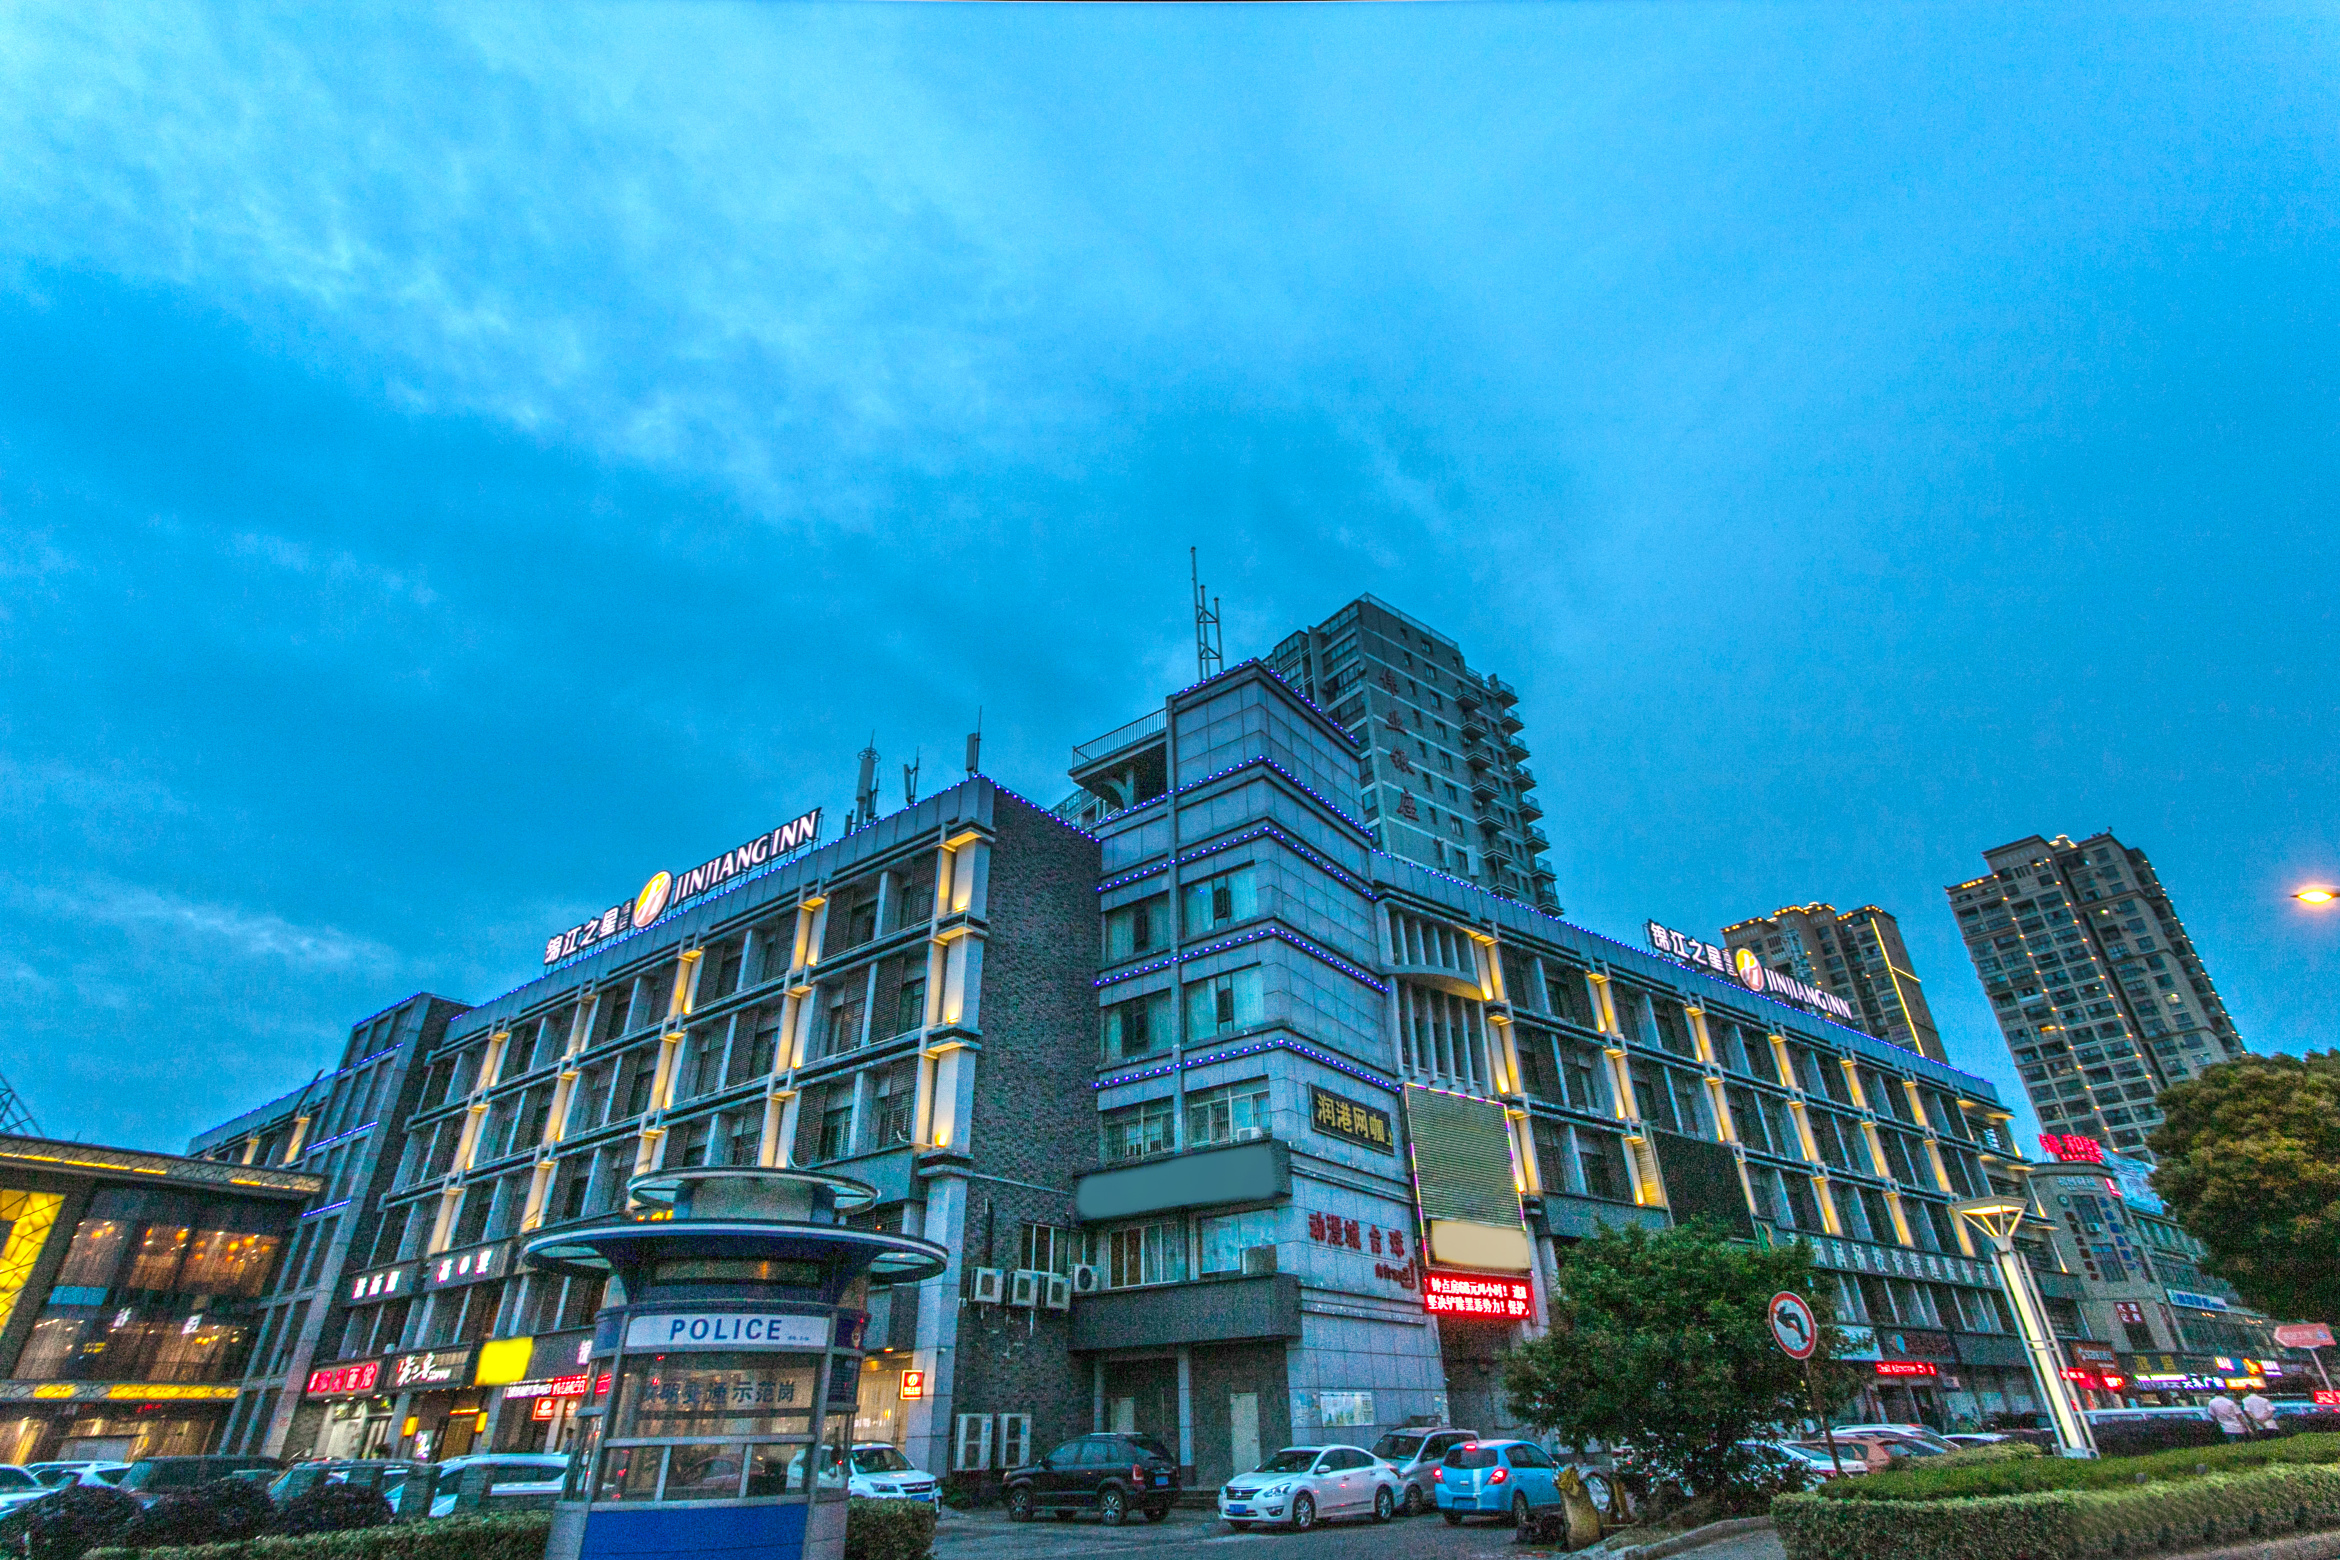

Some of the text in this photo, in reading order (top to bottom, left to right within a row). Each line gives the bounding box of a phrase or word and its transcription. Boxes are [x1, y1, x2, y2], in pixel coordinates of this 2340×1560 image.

[674, 810, 820, 903] JINJIANG INN
[544, 907, 619, 963] 锦江之星
[1650, 922, 1725, 972] 锦江之星
[1764, 968, 1853, 1020] JINJIANG INN
[1317, 1093, 1385, 1143] 润港网咖
[1308, 1211, 1361, 1250] 动漫城
[669, 1318, 783, 1340] POLICE
